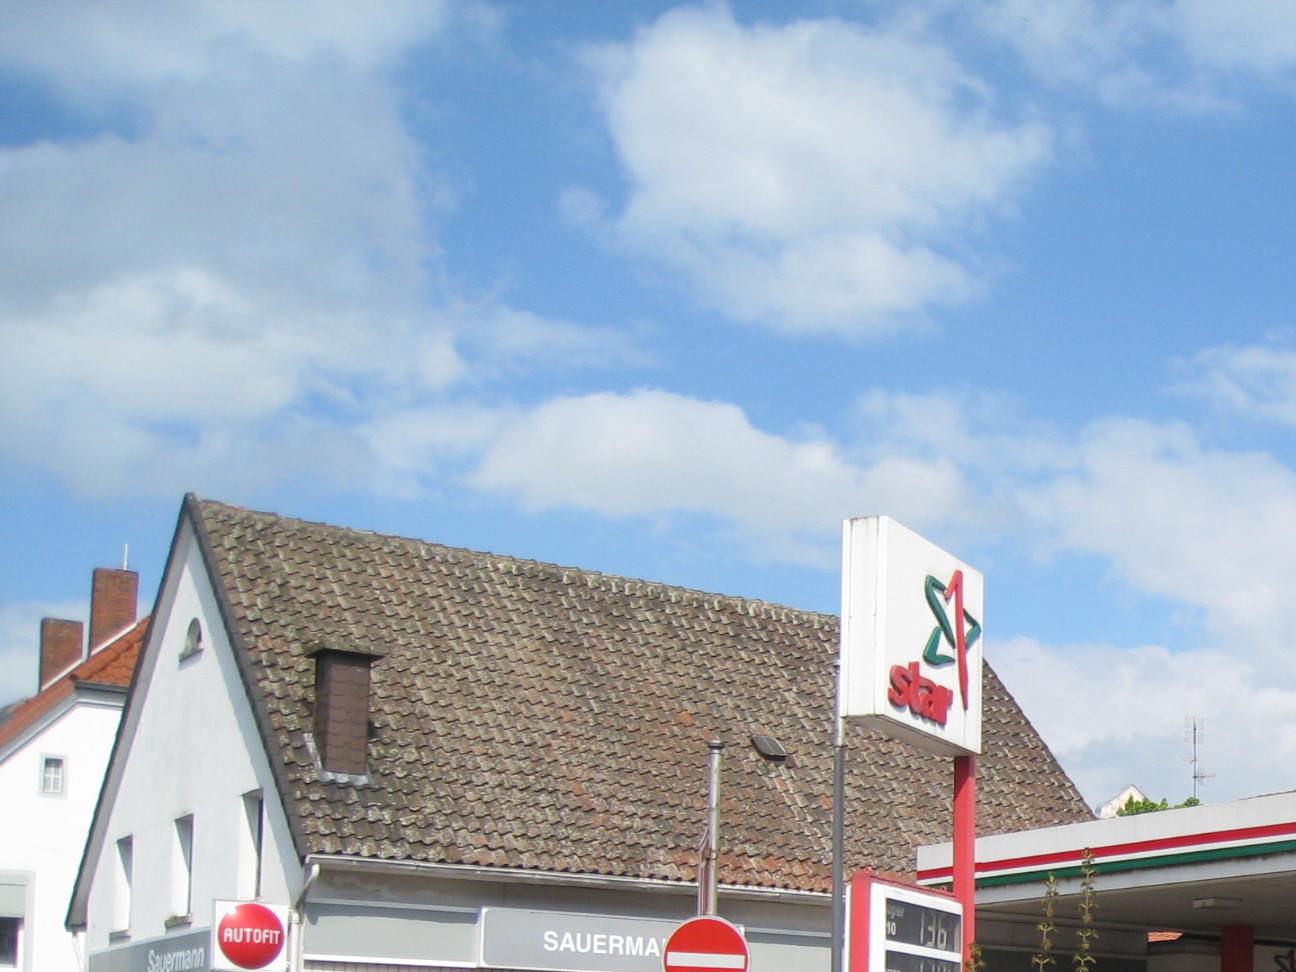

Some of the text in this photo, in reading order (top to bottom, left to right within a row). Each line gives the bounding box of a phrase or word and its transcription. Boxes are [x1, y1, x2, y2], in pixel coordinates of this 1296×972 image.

[888, 661, 953, 725] star
[223, 927, 281, 945] AUTOFIT
[886, 920, 897, 936] 10
[543, 930, 668, 957] SAUERMA
